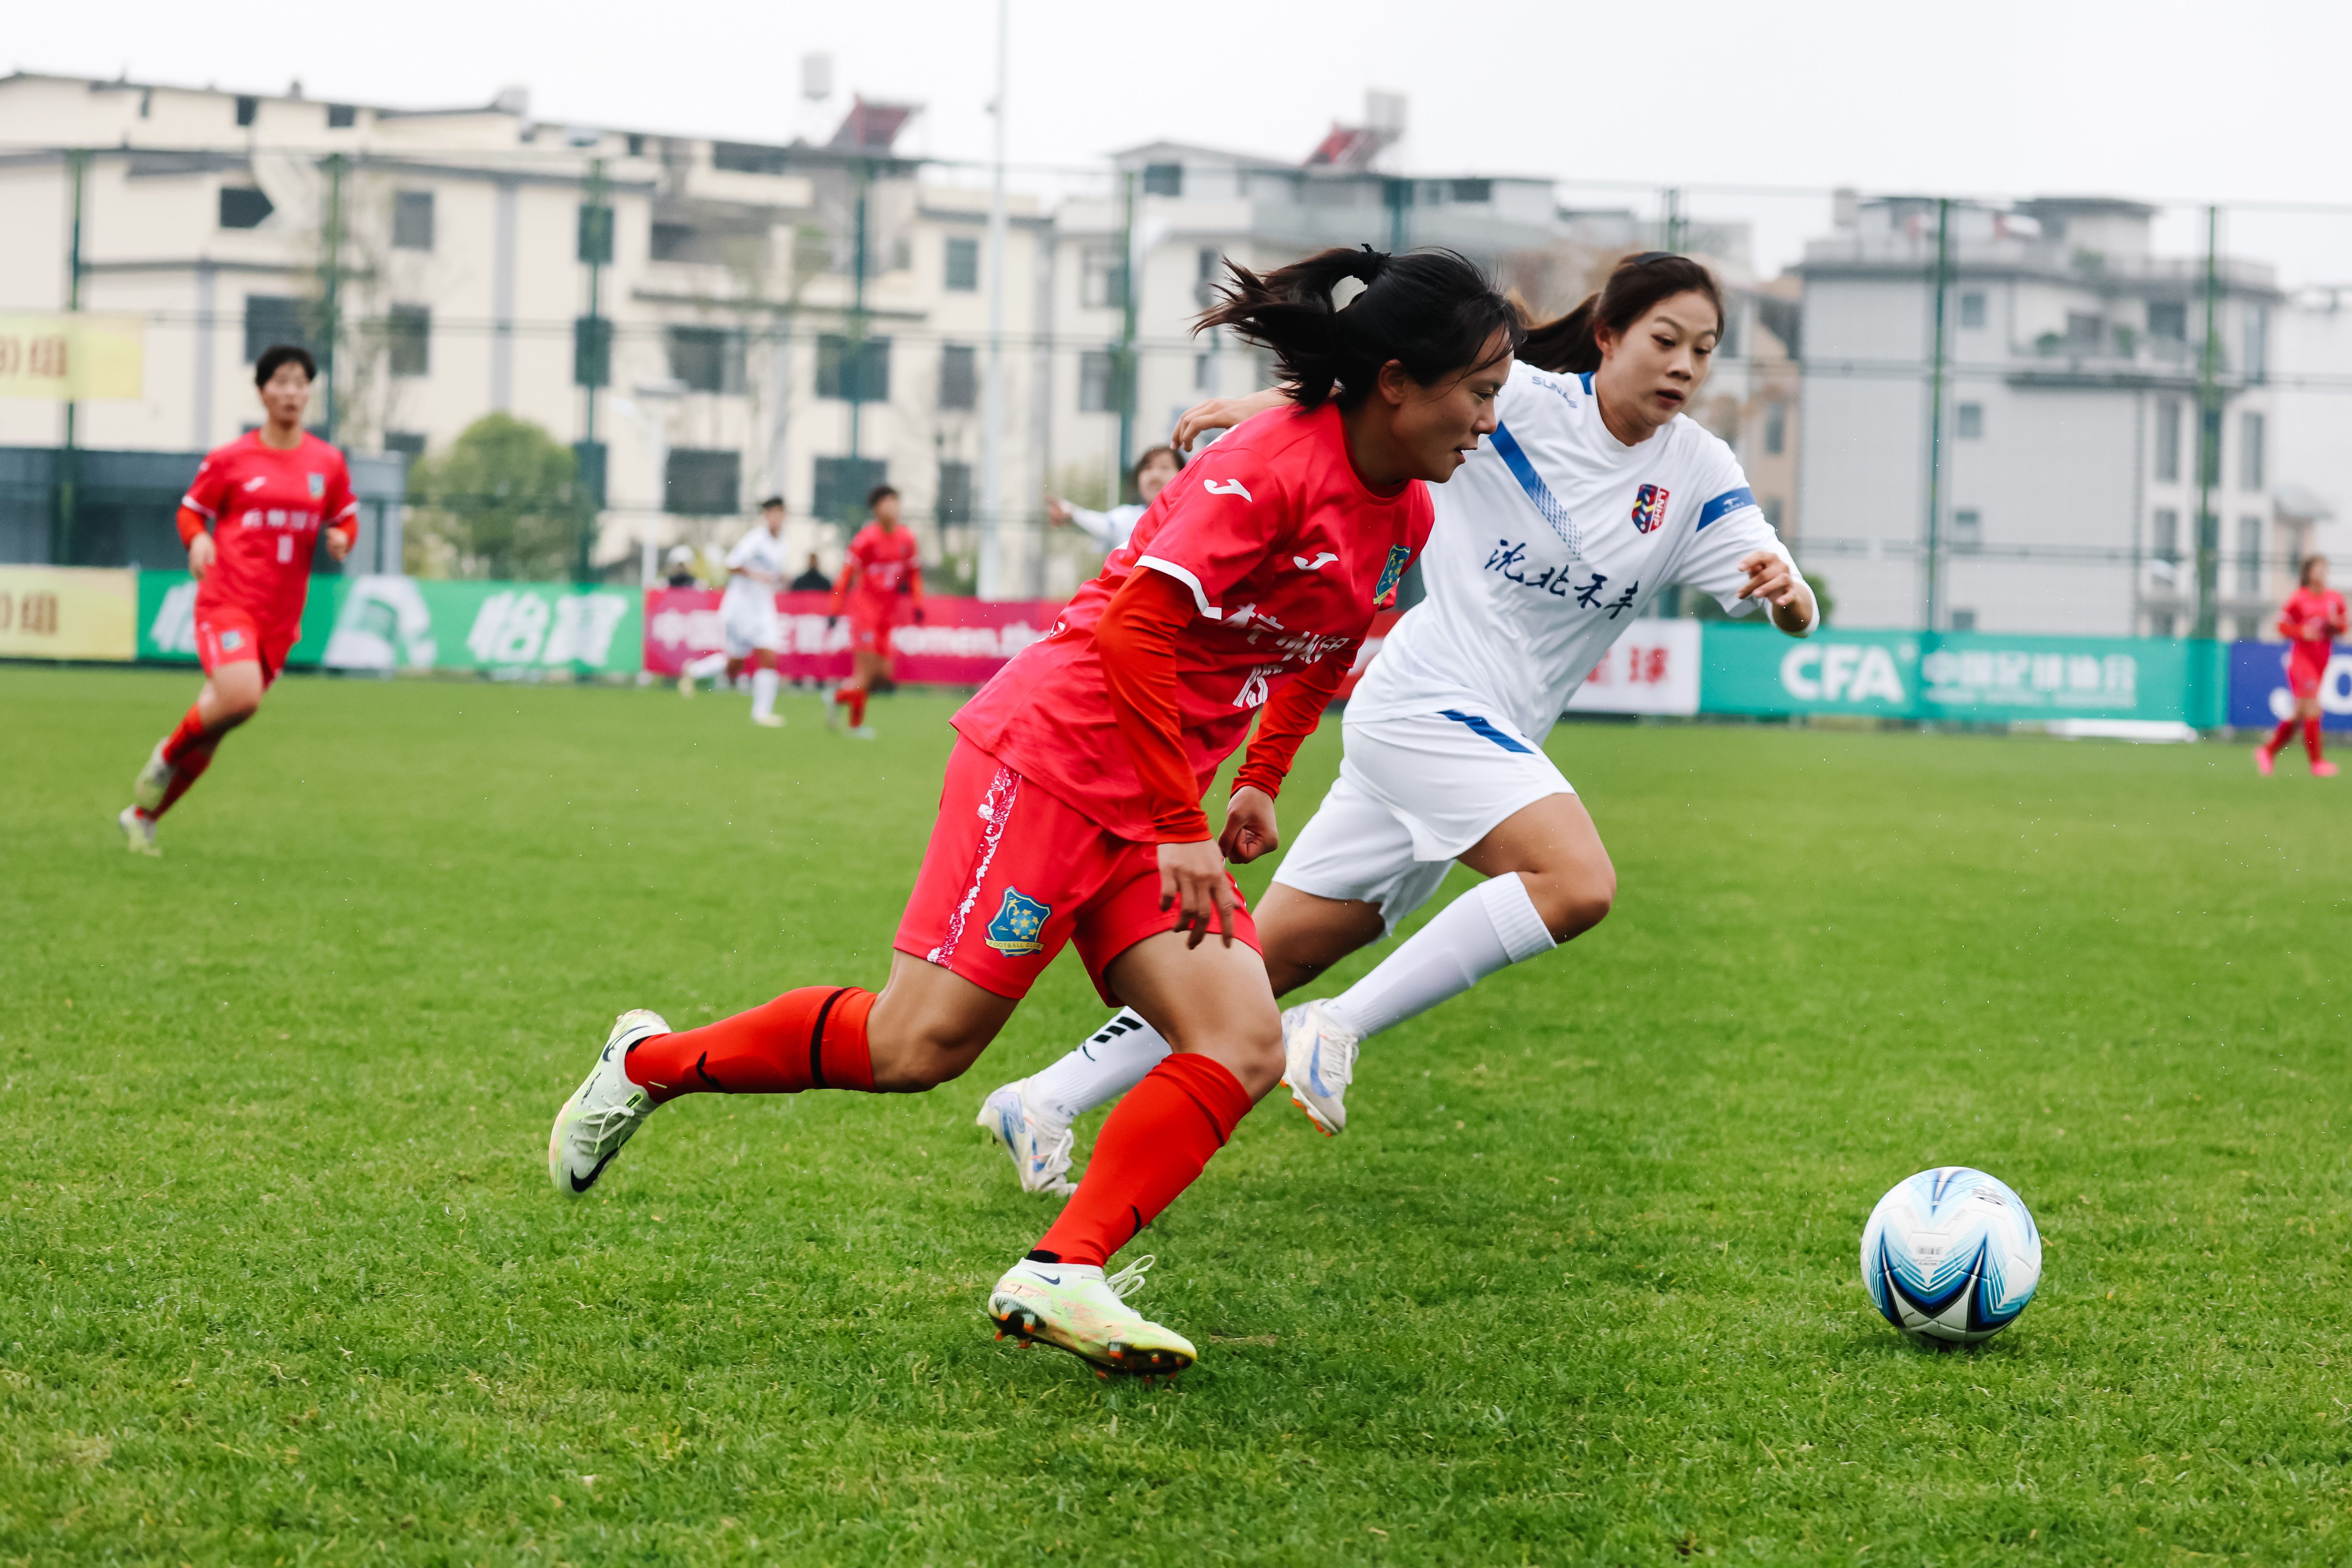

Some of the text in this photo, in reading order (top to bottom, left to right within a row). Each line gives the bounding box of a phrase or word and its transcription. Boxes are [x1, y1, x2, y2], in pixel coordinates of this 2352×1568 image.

[1653, 490, 1666, 527] LNHF
[1232, 664, 1285, 709] 15
[1779, 643, 1905, 703] CFA
